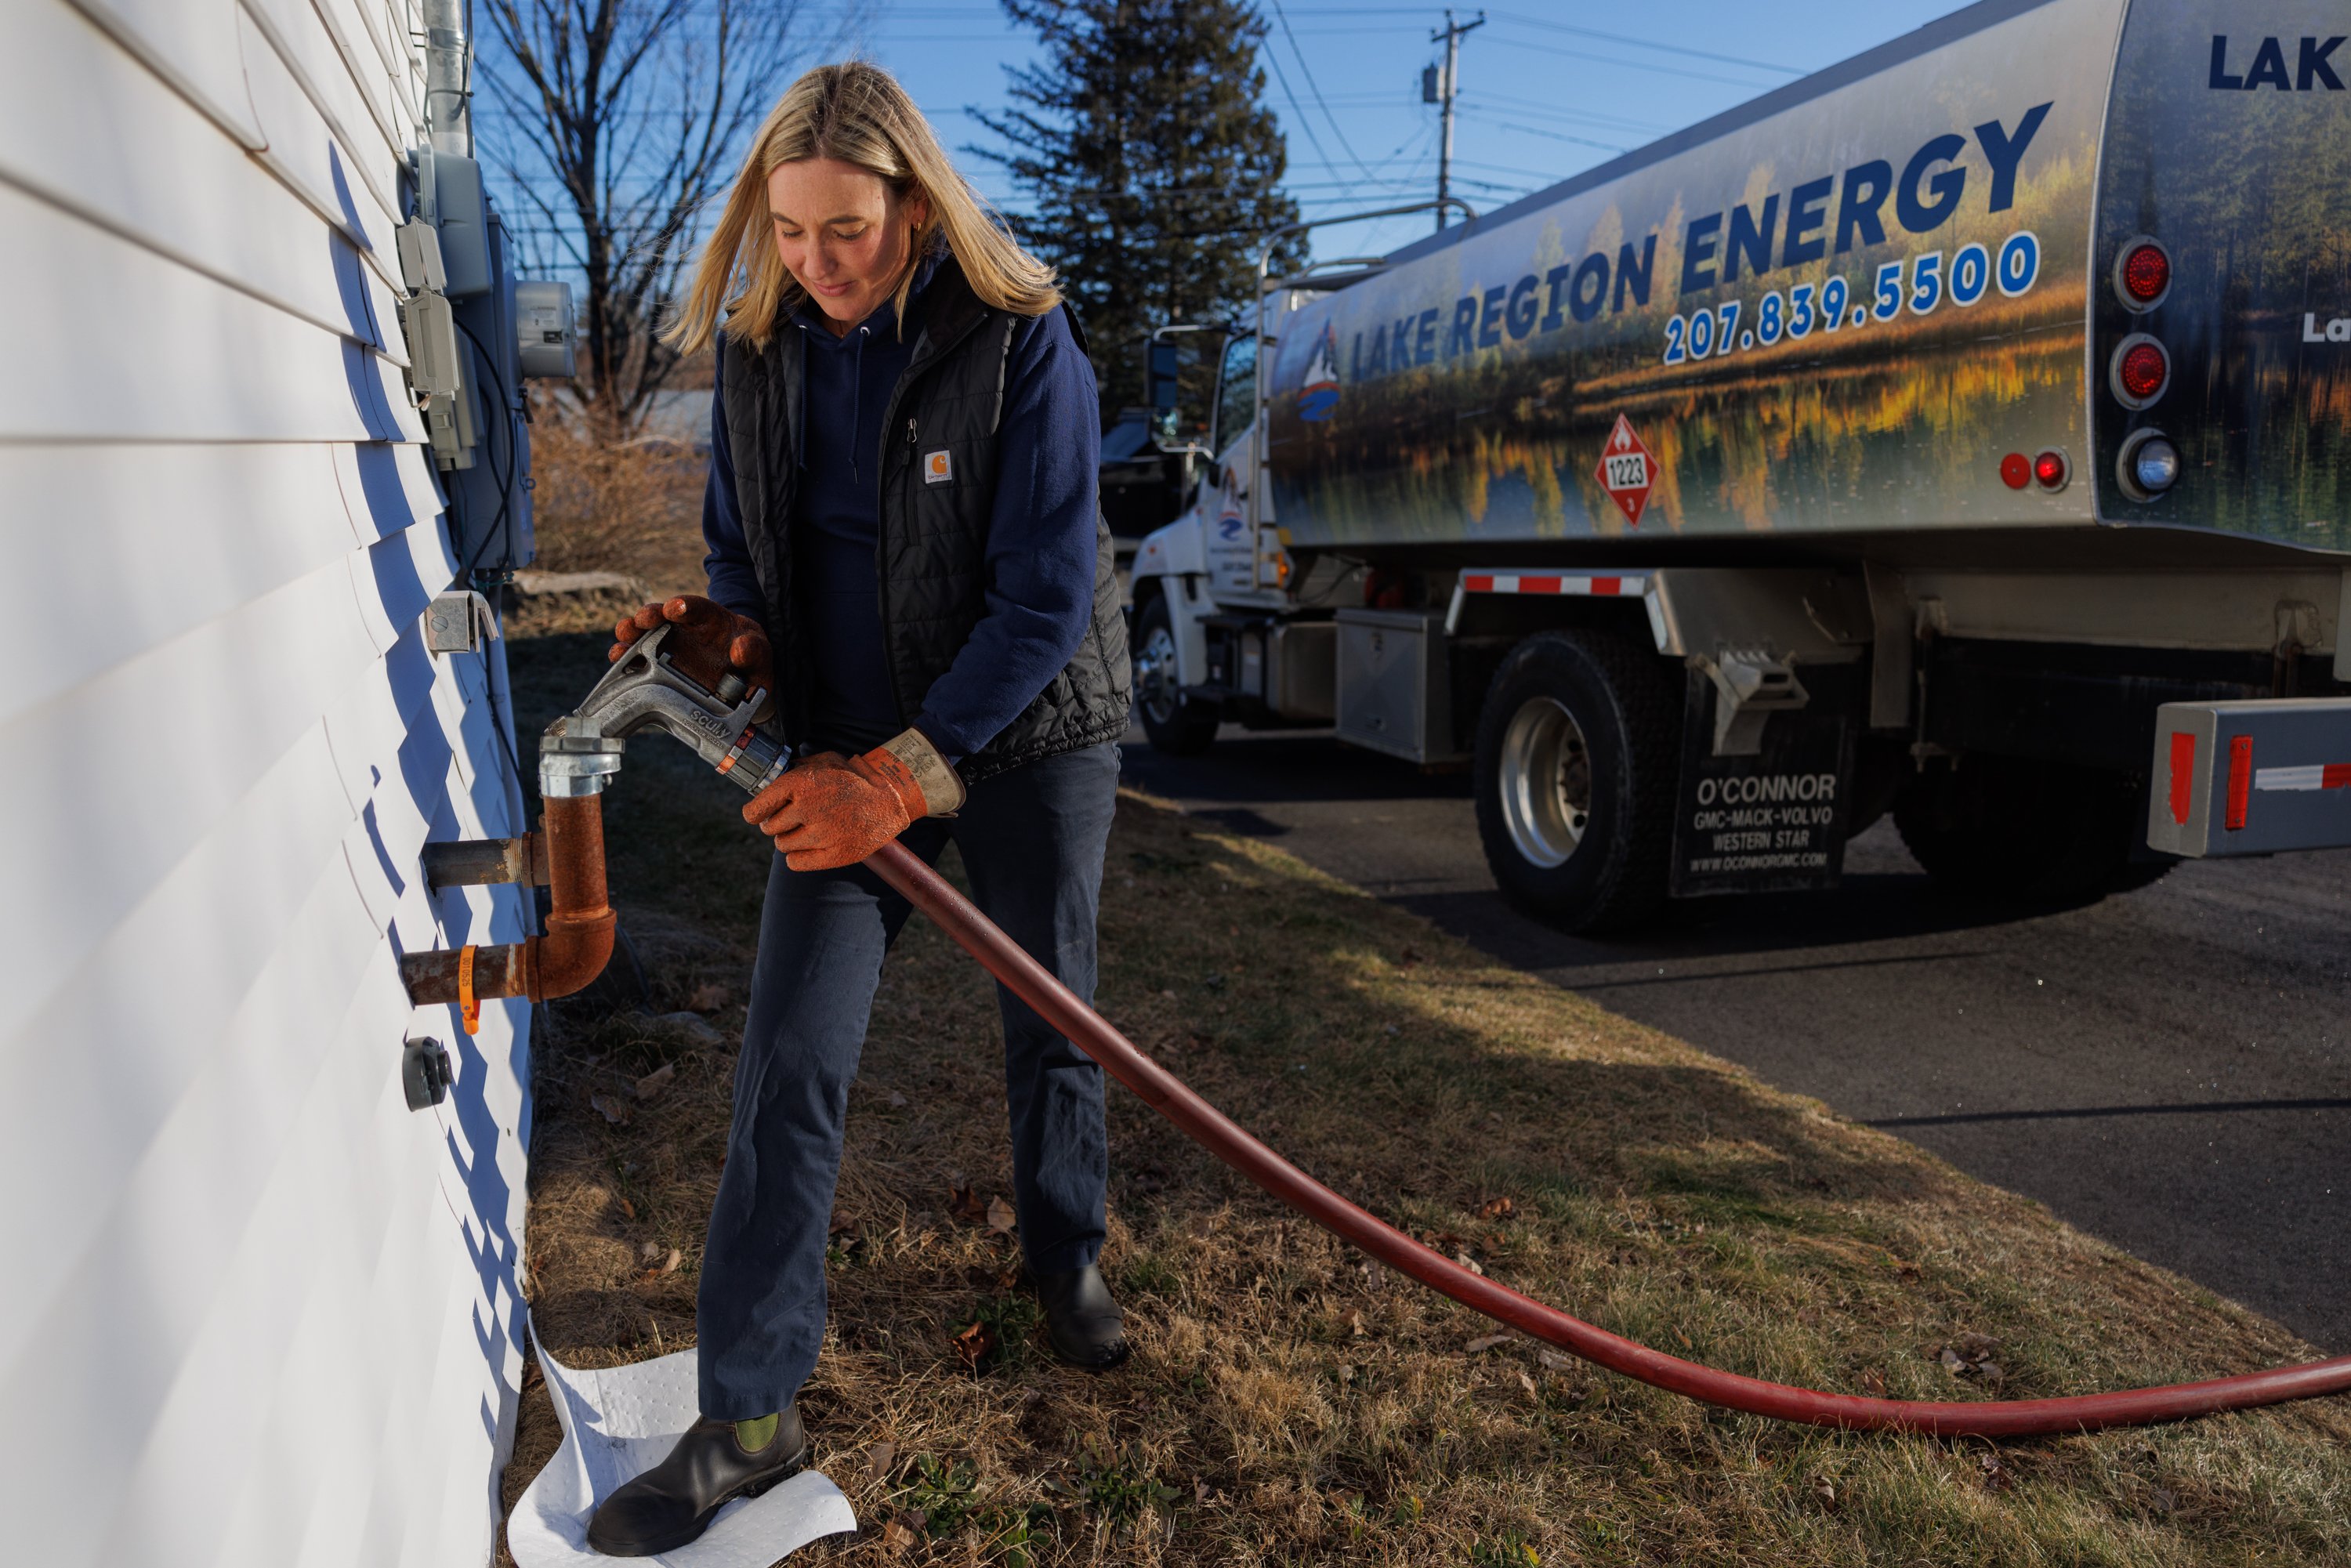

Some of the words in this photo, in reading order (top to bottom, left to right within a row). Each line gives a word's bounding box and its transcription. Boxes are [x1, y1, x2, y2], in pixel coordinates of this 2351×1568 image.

[2208, 35, 2349, 91] LAK
[1351, 307, 1439, 384] LAKE
[1450, 234, 1657, 358] REGION
[1681, 100, 2055, 295] ENERGY
[1663, 230, 2041, 366] 207.839.5500
[2302, 312, 2351, 342] La
[1609, 457, 1644, 487] 1223
[1626, 497, 1636, 513] 3
[1697, 774, 1837, 806] O'CONNOR
[1694, 806, 1834, 831] GMC-MACK-VOLVO
[1712, 831, 1772, 852] WESTERN
[1775, 829, 1810, 849] STAR
[461, 957, 472, 987] 0010525
